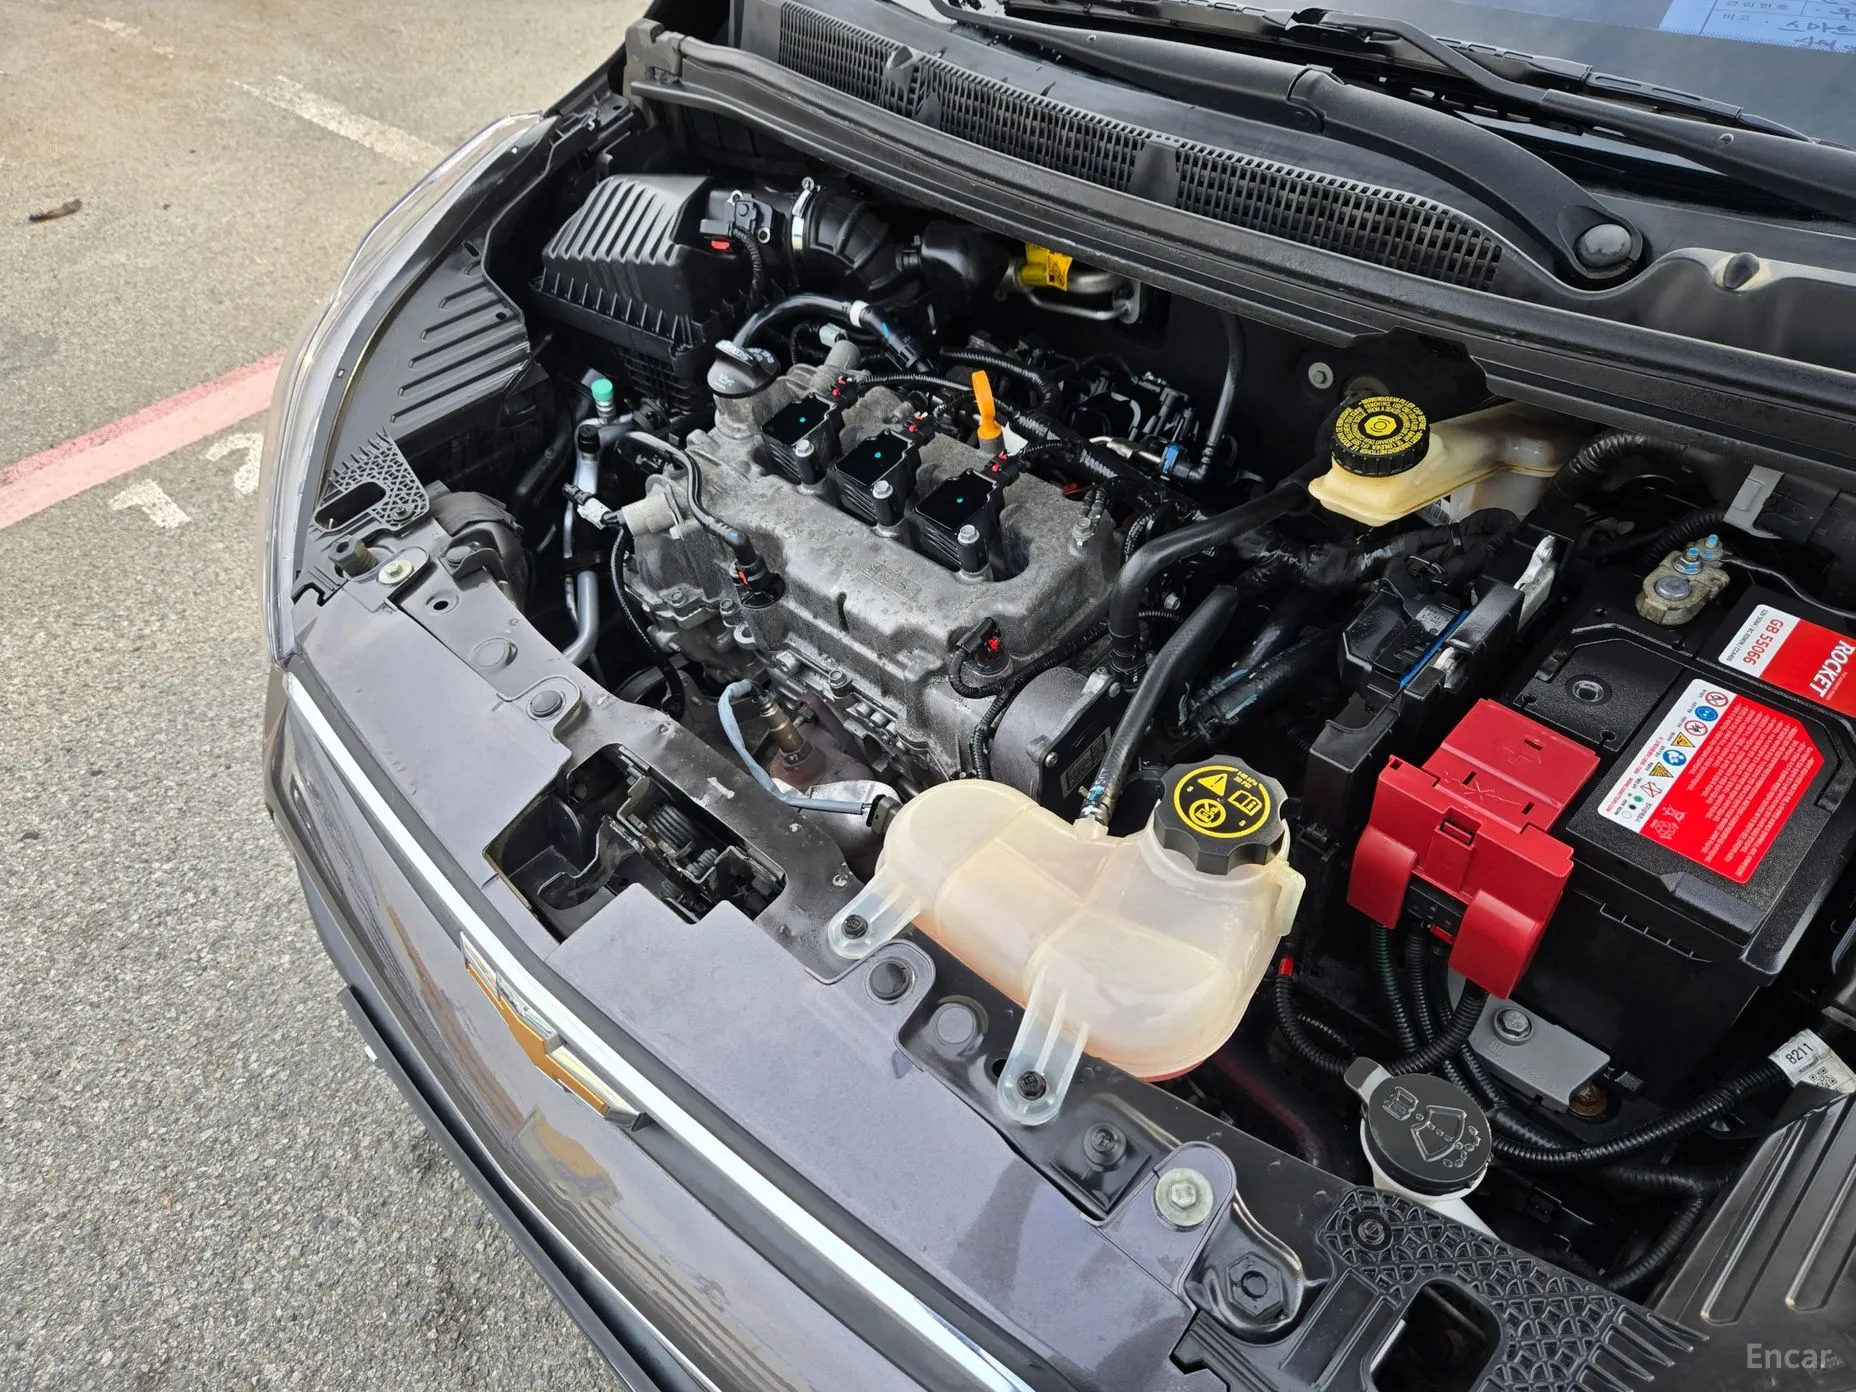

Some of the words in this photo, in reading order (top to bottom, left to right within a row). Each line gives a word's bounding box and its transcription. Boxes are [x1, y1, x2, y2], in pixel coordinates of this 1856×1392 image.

[1766, 619, 1784, 634] GB
[1743, 633, 1773, 665] 55066
[1809, 640, 1856, 698] ROCKET
[1785, 1043, 1813, 1064] 8211
